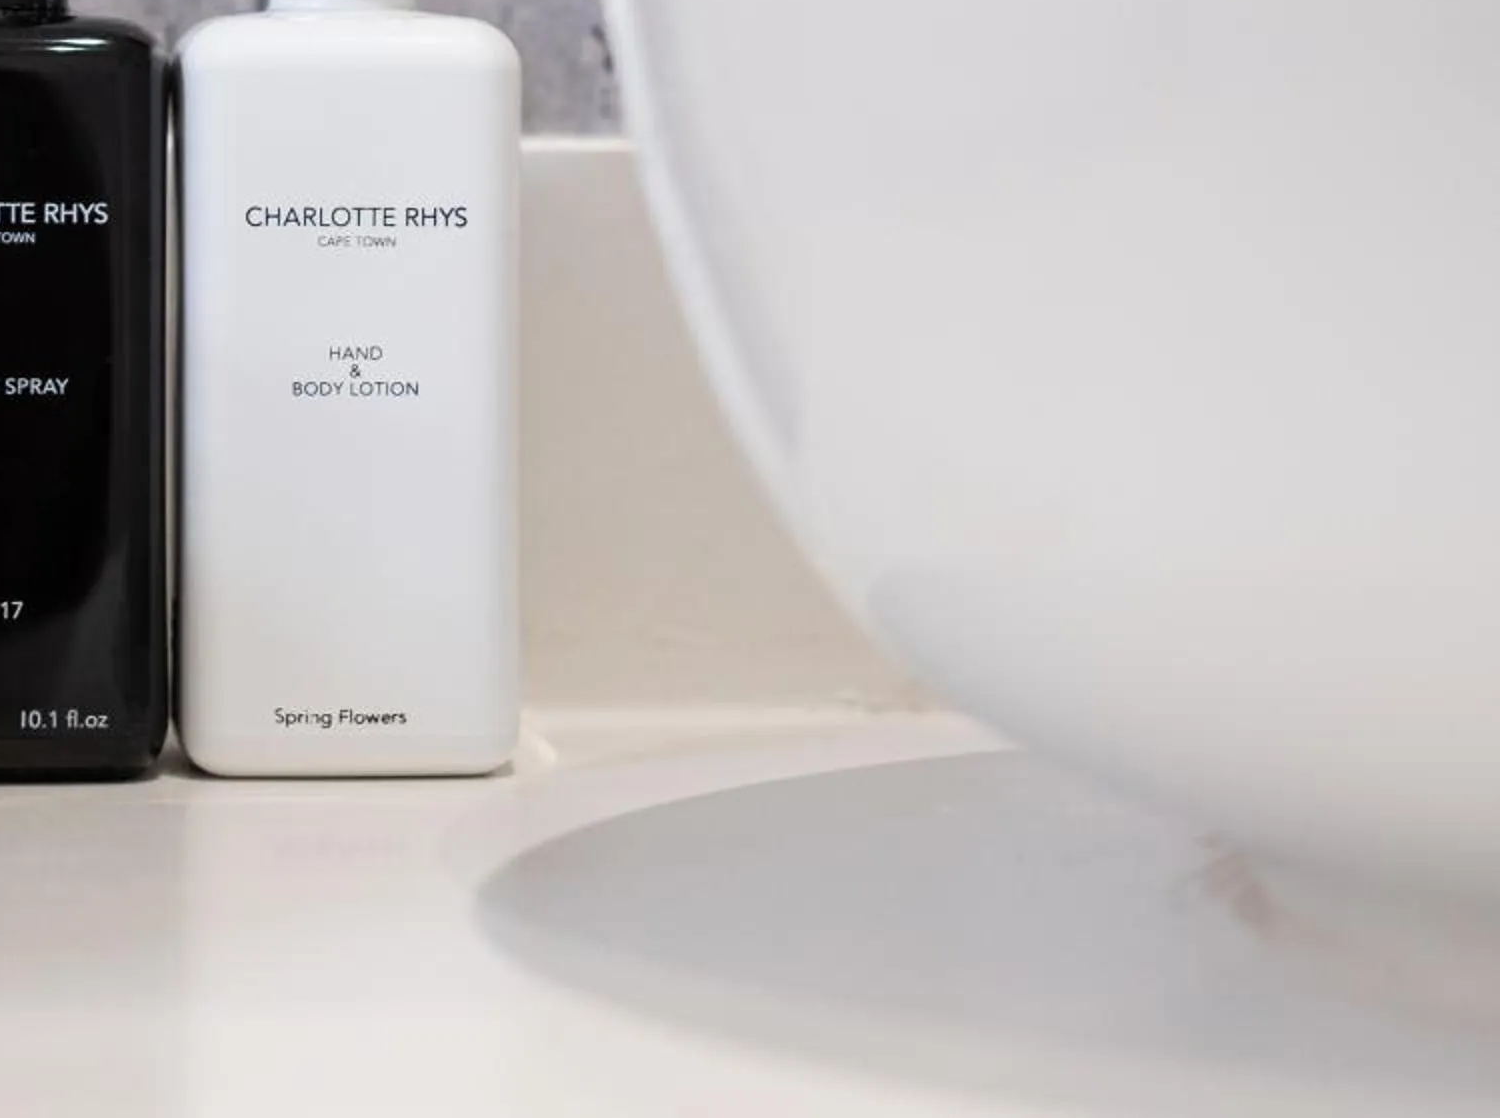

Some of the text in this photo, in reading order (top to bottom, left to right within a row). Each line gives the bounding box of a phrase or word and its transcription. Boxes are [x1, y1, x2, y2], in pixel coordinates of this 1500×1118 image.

[43, 201, 109, 225] RHYS
[245, 206, 468, 228] CHARLOTTE RHYS
[317, 235, 396, 248] CAPE TOWN
[328, 345, 383, 362] HAND
[349, 363, 361, 378] &
[4, 377, 69, 396] SPRAY
[291, 381, 419, 397] BODY LOTION
[0, 600, 24, 620] 17
[20, 708, 109, 730] 10.1 fl.oz
[273, 707, 407, 729] Spring Flowers
